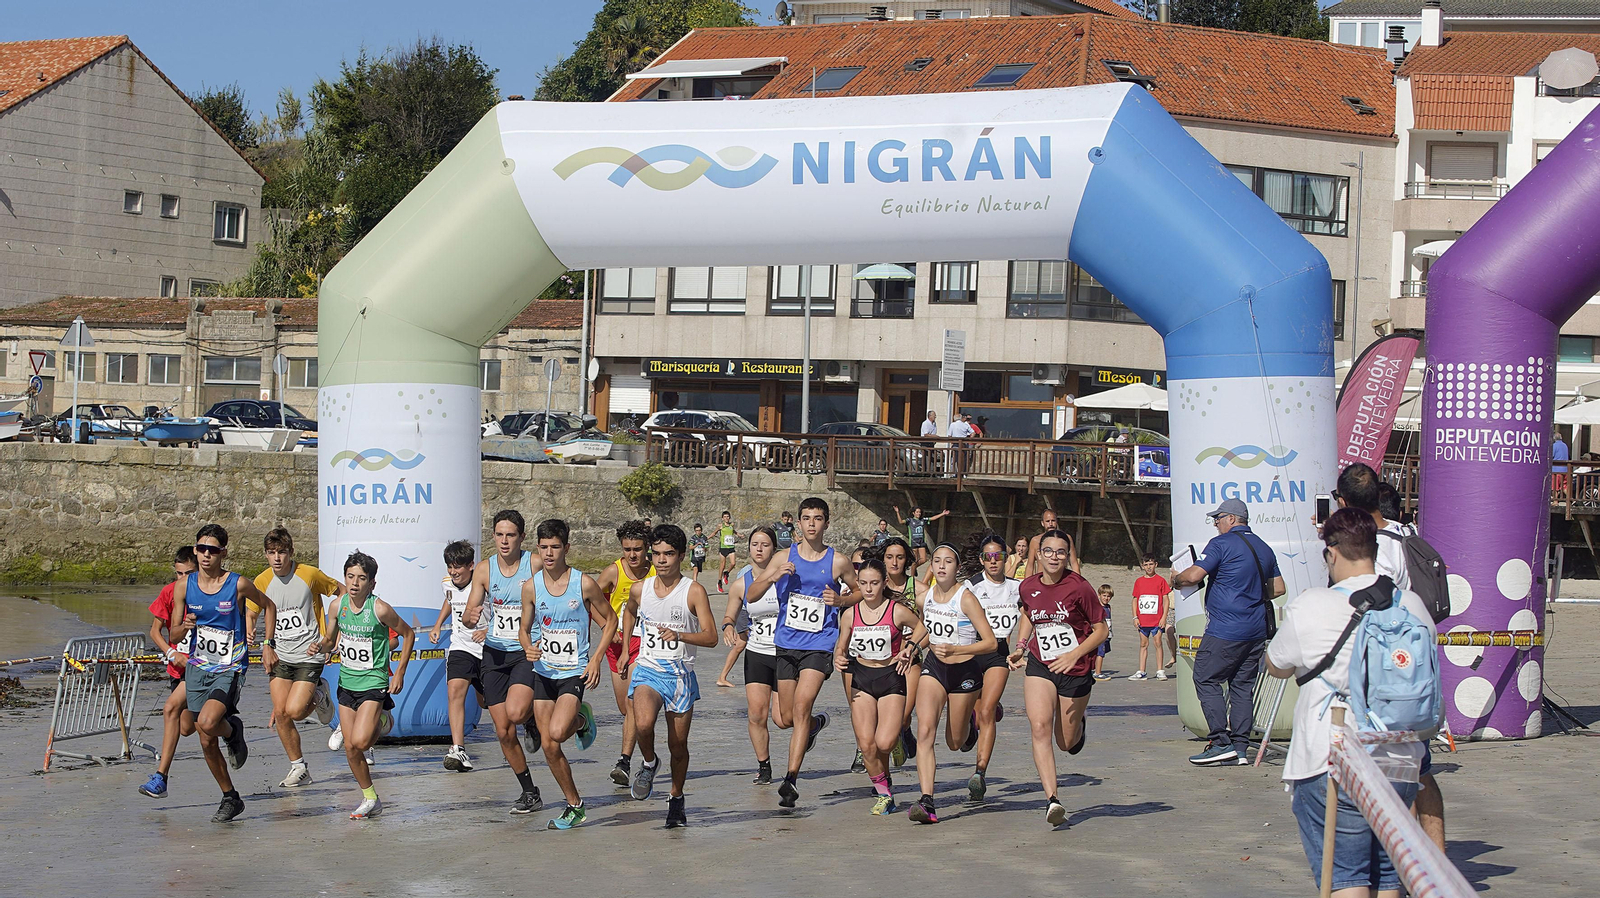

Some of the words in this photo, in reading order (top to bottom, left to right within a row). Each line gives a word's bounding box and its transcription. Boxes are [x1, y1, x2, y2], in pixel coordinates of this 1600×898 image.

[792, 127, 1052, 185] NIGRÁN
[880, 198, 969, 218] Equilibrio
[976, 194, 1051, 214] Natural
[650, 360, 720, 375] Marisquería
[741, 361, 814, 374] Restaurane
[1098, 370, 1142, 384] Mesón
[1346, 354, 1389, 457] DEPUTACIÓN
[1360, 359, 1402, 460] PONTEVEDRA
[1436, 426, 1540, 448] DEPUTACIÓN
[1435, 446, 1541, 464] PONTEVEDRA
[327, 478, 432, 506] NIGRÁN
[1191, 475, 1306, 504] NIGRÁN
[336, 515, 377, 527] Equilibrio
[379, 514, 421, 525] Natural
[1255, 513, 1296, 524] Natural
[498, 615, 521, 630] 311
[790, 604, 820, 623] 316
[990, 614, 1018, 630] 301
[276, 615, 302, 631] 320
[347, 624, 374, 632] MIGUEL
[756, 622, 775, 636] 31
[925, 619, 954, 638] 309
[198, 635, 229, 657] 303
[542, 636, 575, 656] 304
[646, 633, 679, 651] 310
[854, 638, 886, 652] 319
[1040, 632, 1072, 651] 315
[339, 643, 370, 662] 308
[420, 649, 446, 660] GADIS
